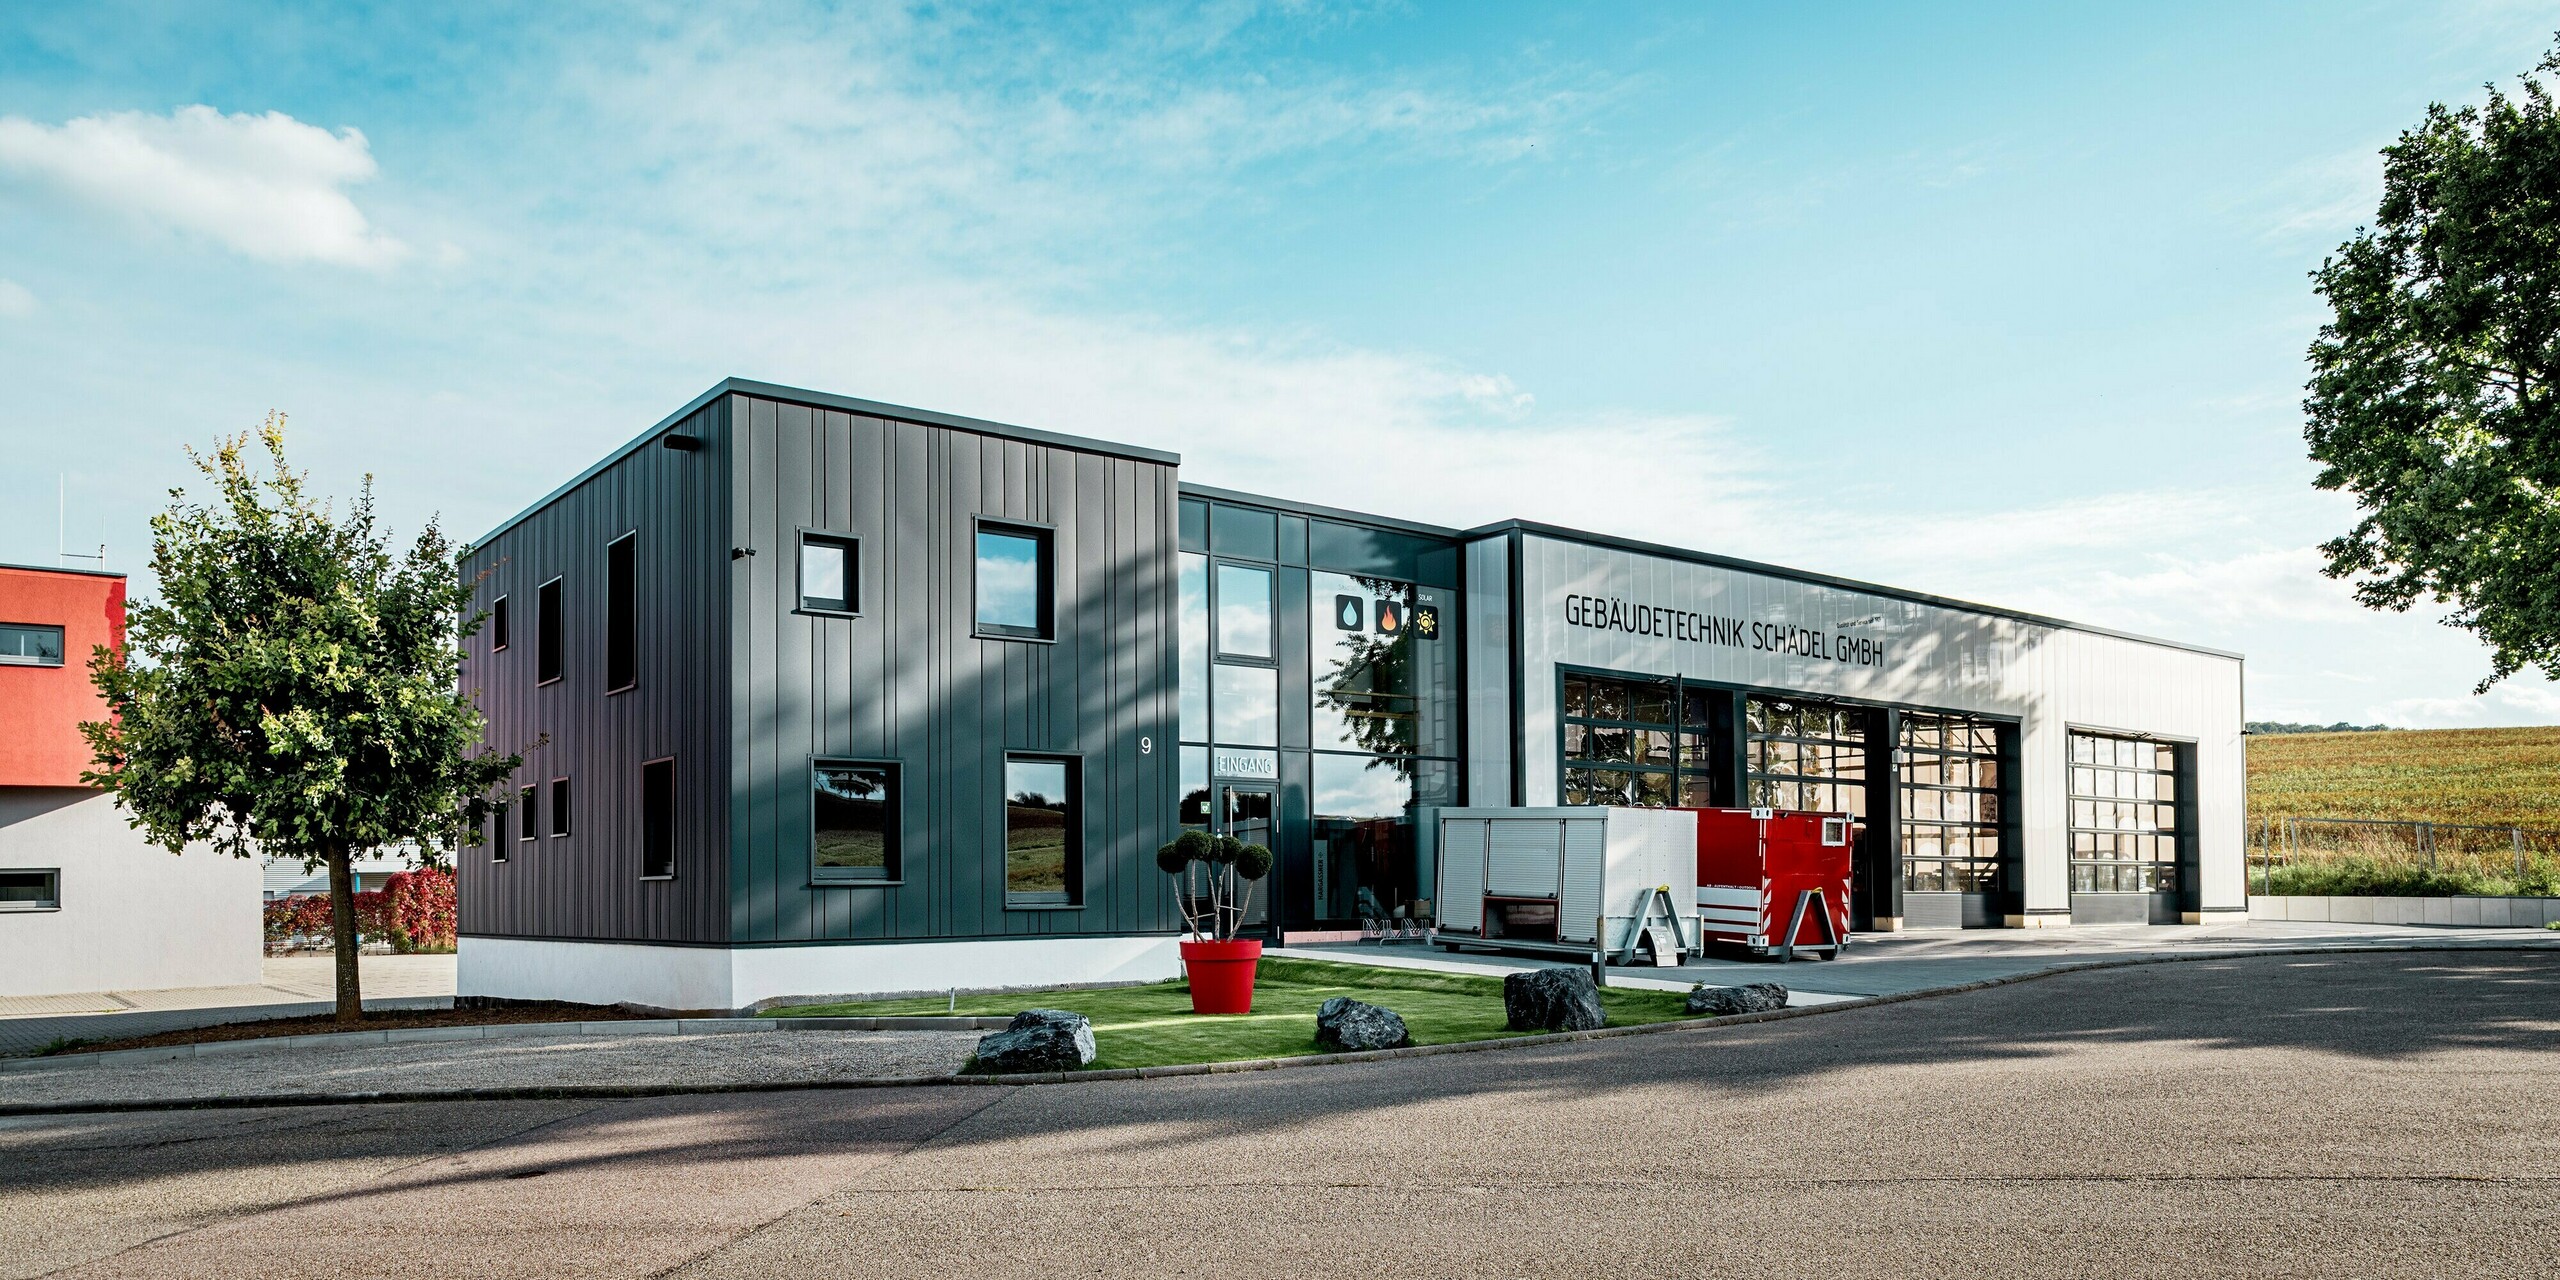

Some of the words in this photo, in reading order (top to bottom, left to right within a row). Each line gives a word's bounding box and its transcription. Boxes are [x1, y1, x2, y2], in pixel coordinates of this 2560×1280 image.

[1418, 594, 1433, 602] SOLAR
[1565, 594, 1745, 648] GEBÄUDETECHNIK
[1752, 621, 1832, 660] SCHÄDEL
[1836, 635, 1883, 667] GMBH
[1141, 736, 1152, 754] 9
[1218, 756, 1273, 773] EINGANG
